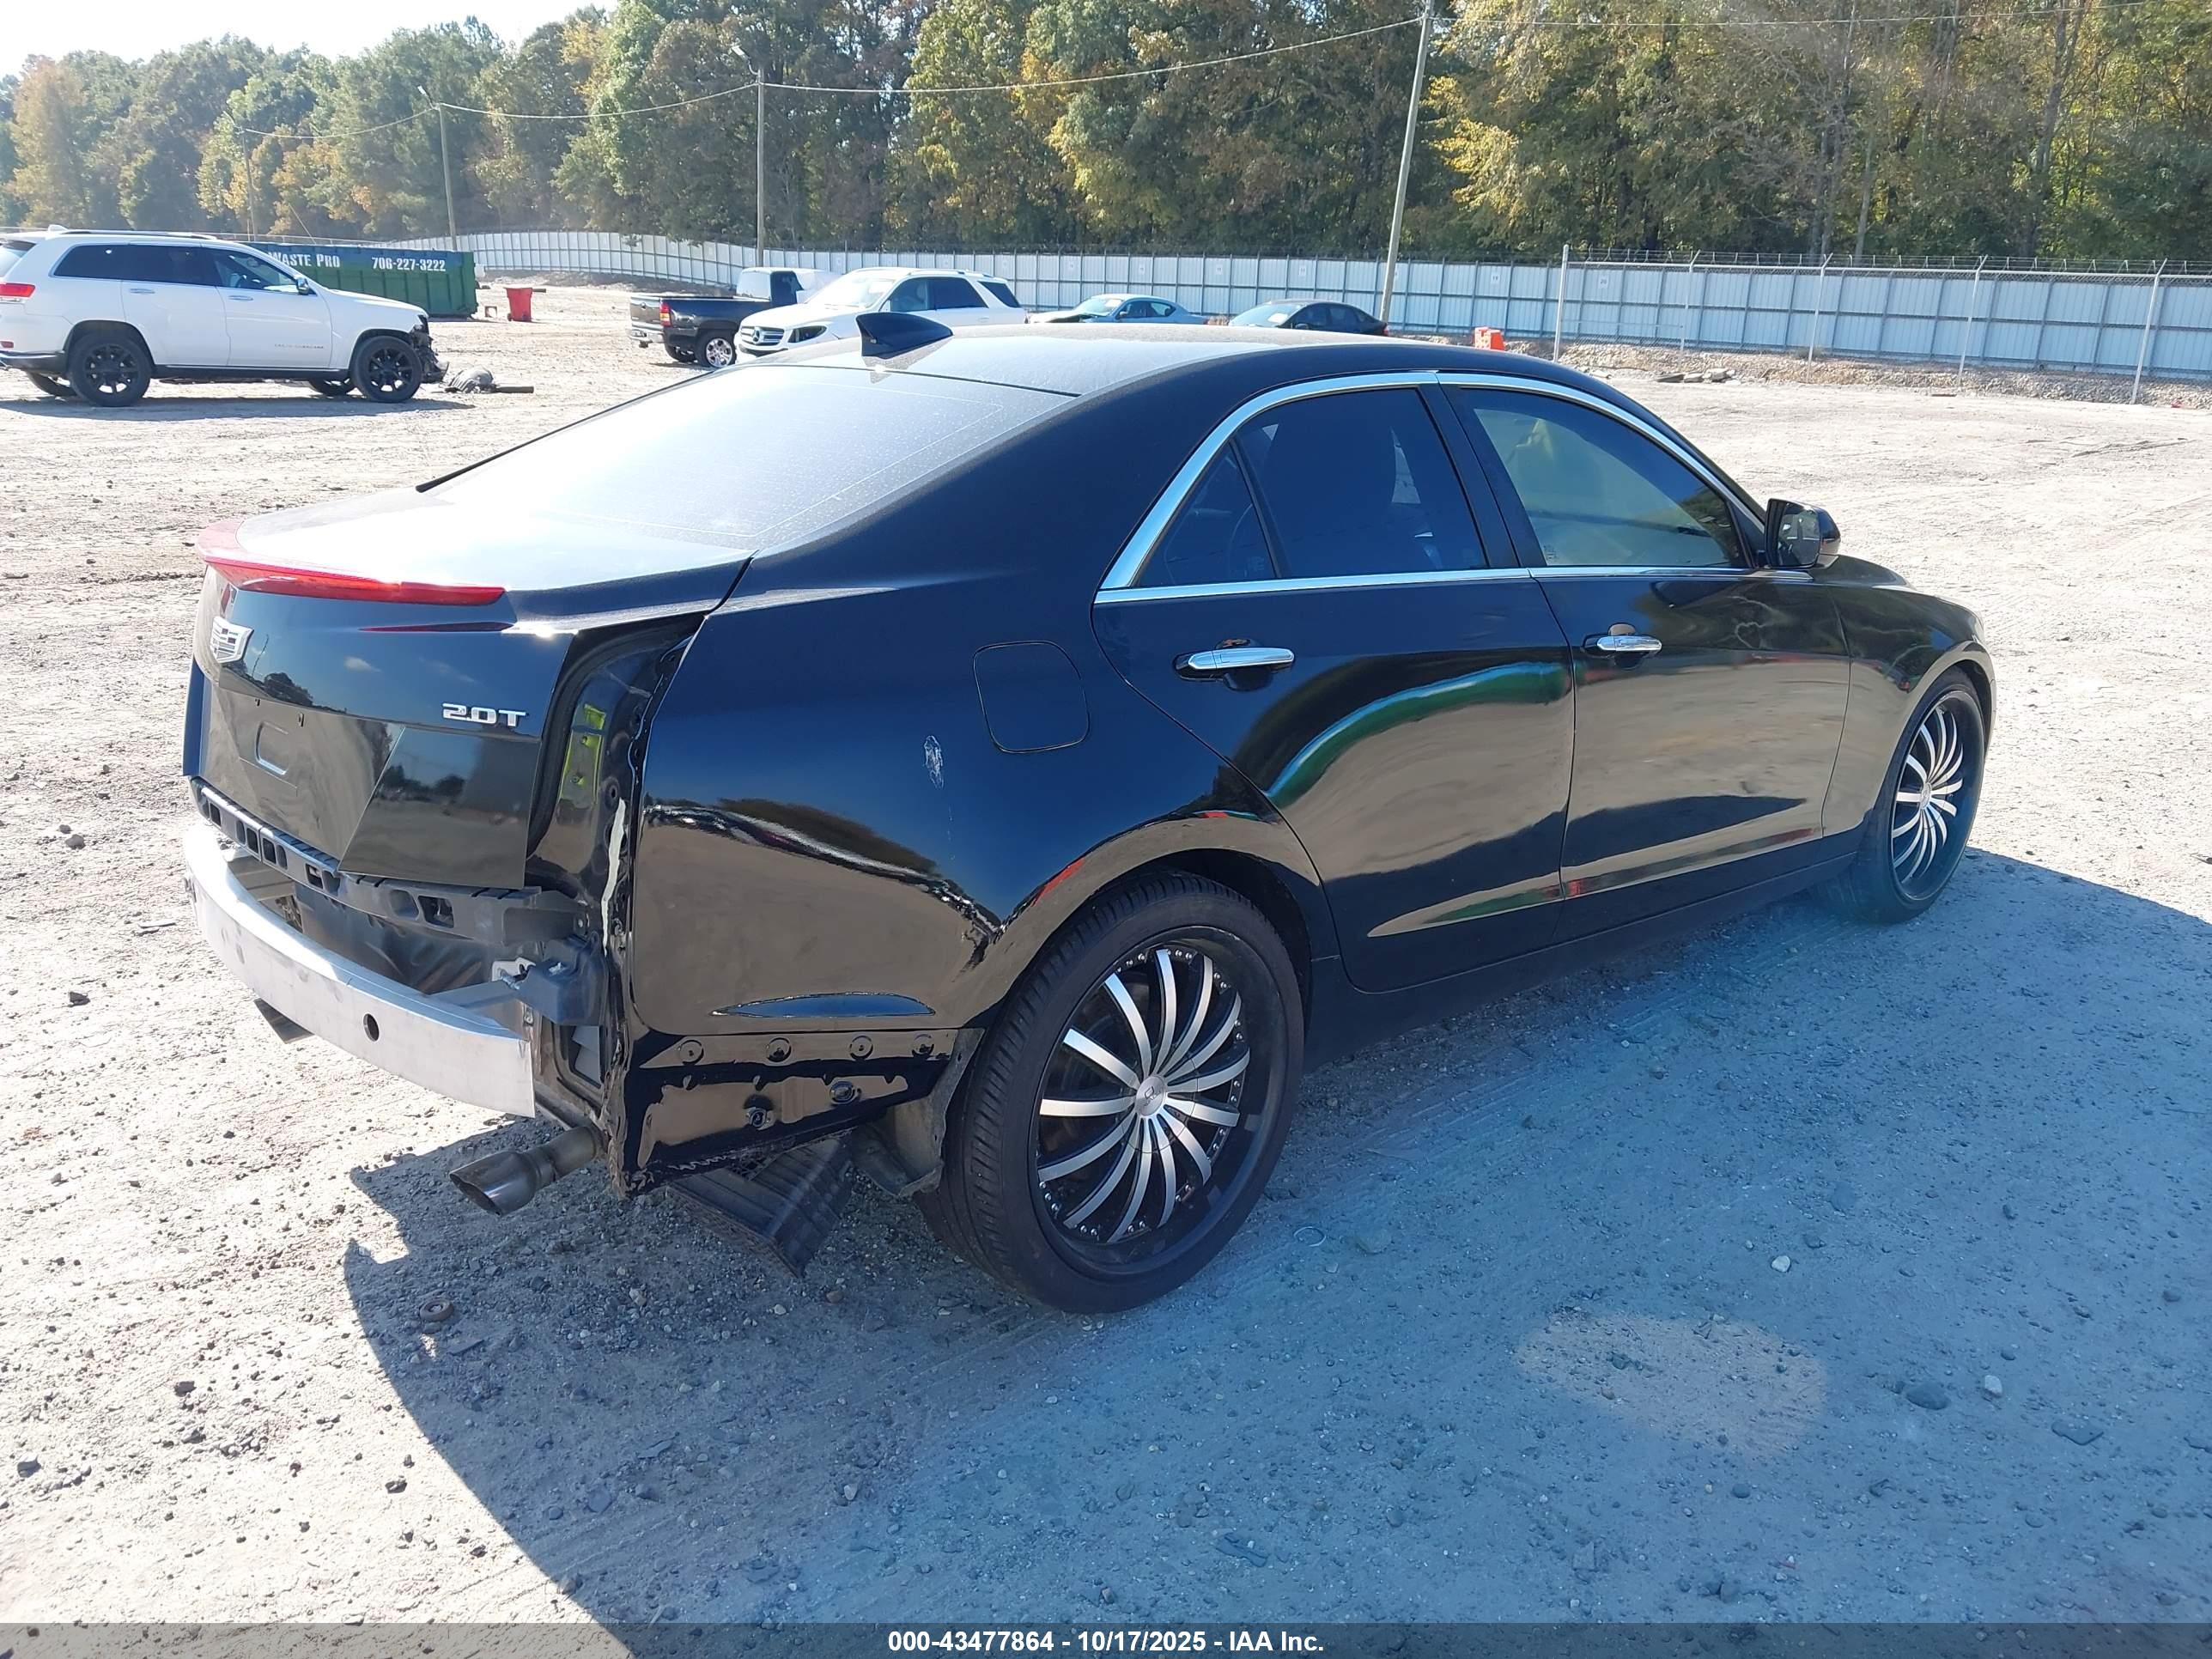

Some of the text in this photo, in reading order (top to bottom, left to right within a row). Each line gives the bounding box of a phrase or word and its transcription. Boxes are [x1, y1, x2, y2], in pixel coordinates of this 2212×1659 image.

[268, 252, 312, 267] WASTE
[371, 257, 447, 272] 706-227-3222
[442, 702, 526, 727] 2.0T
